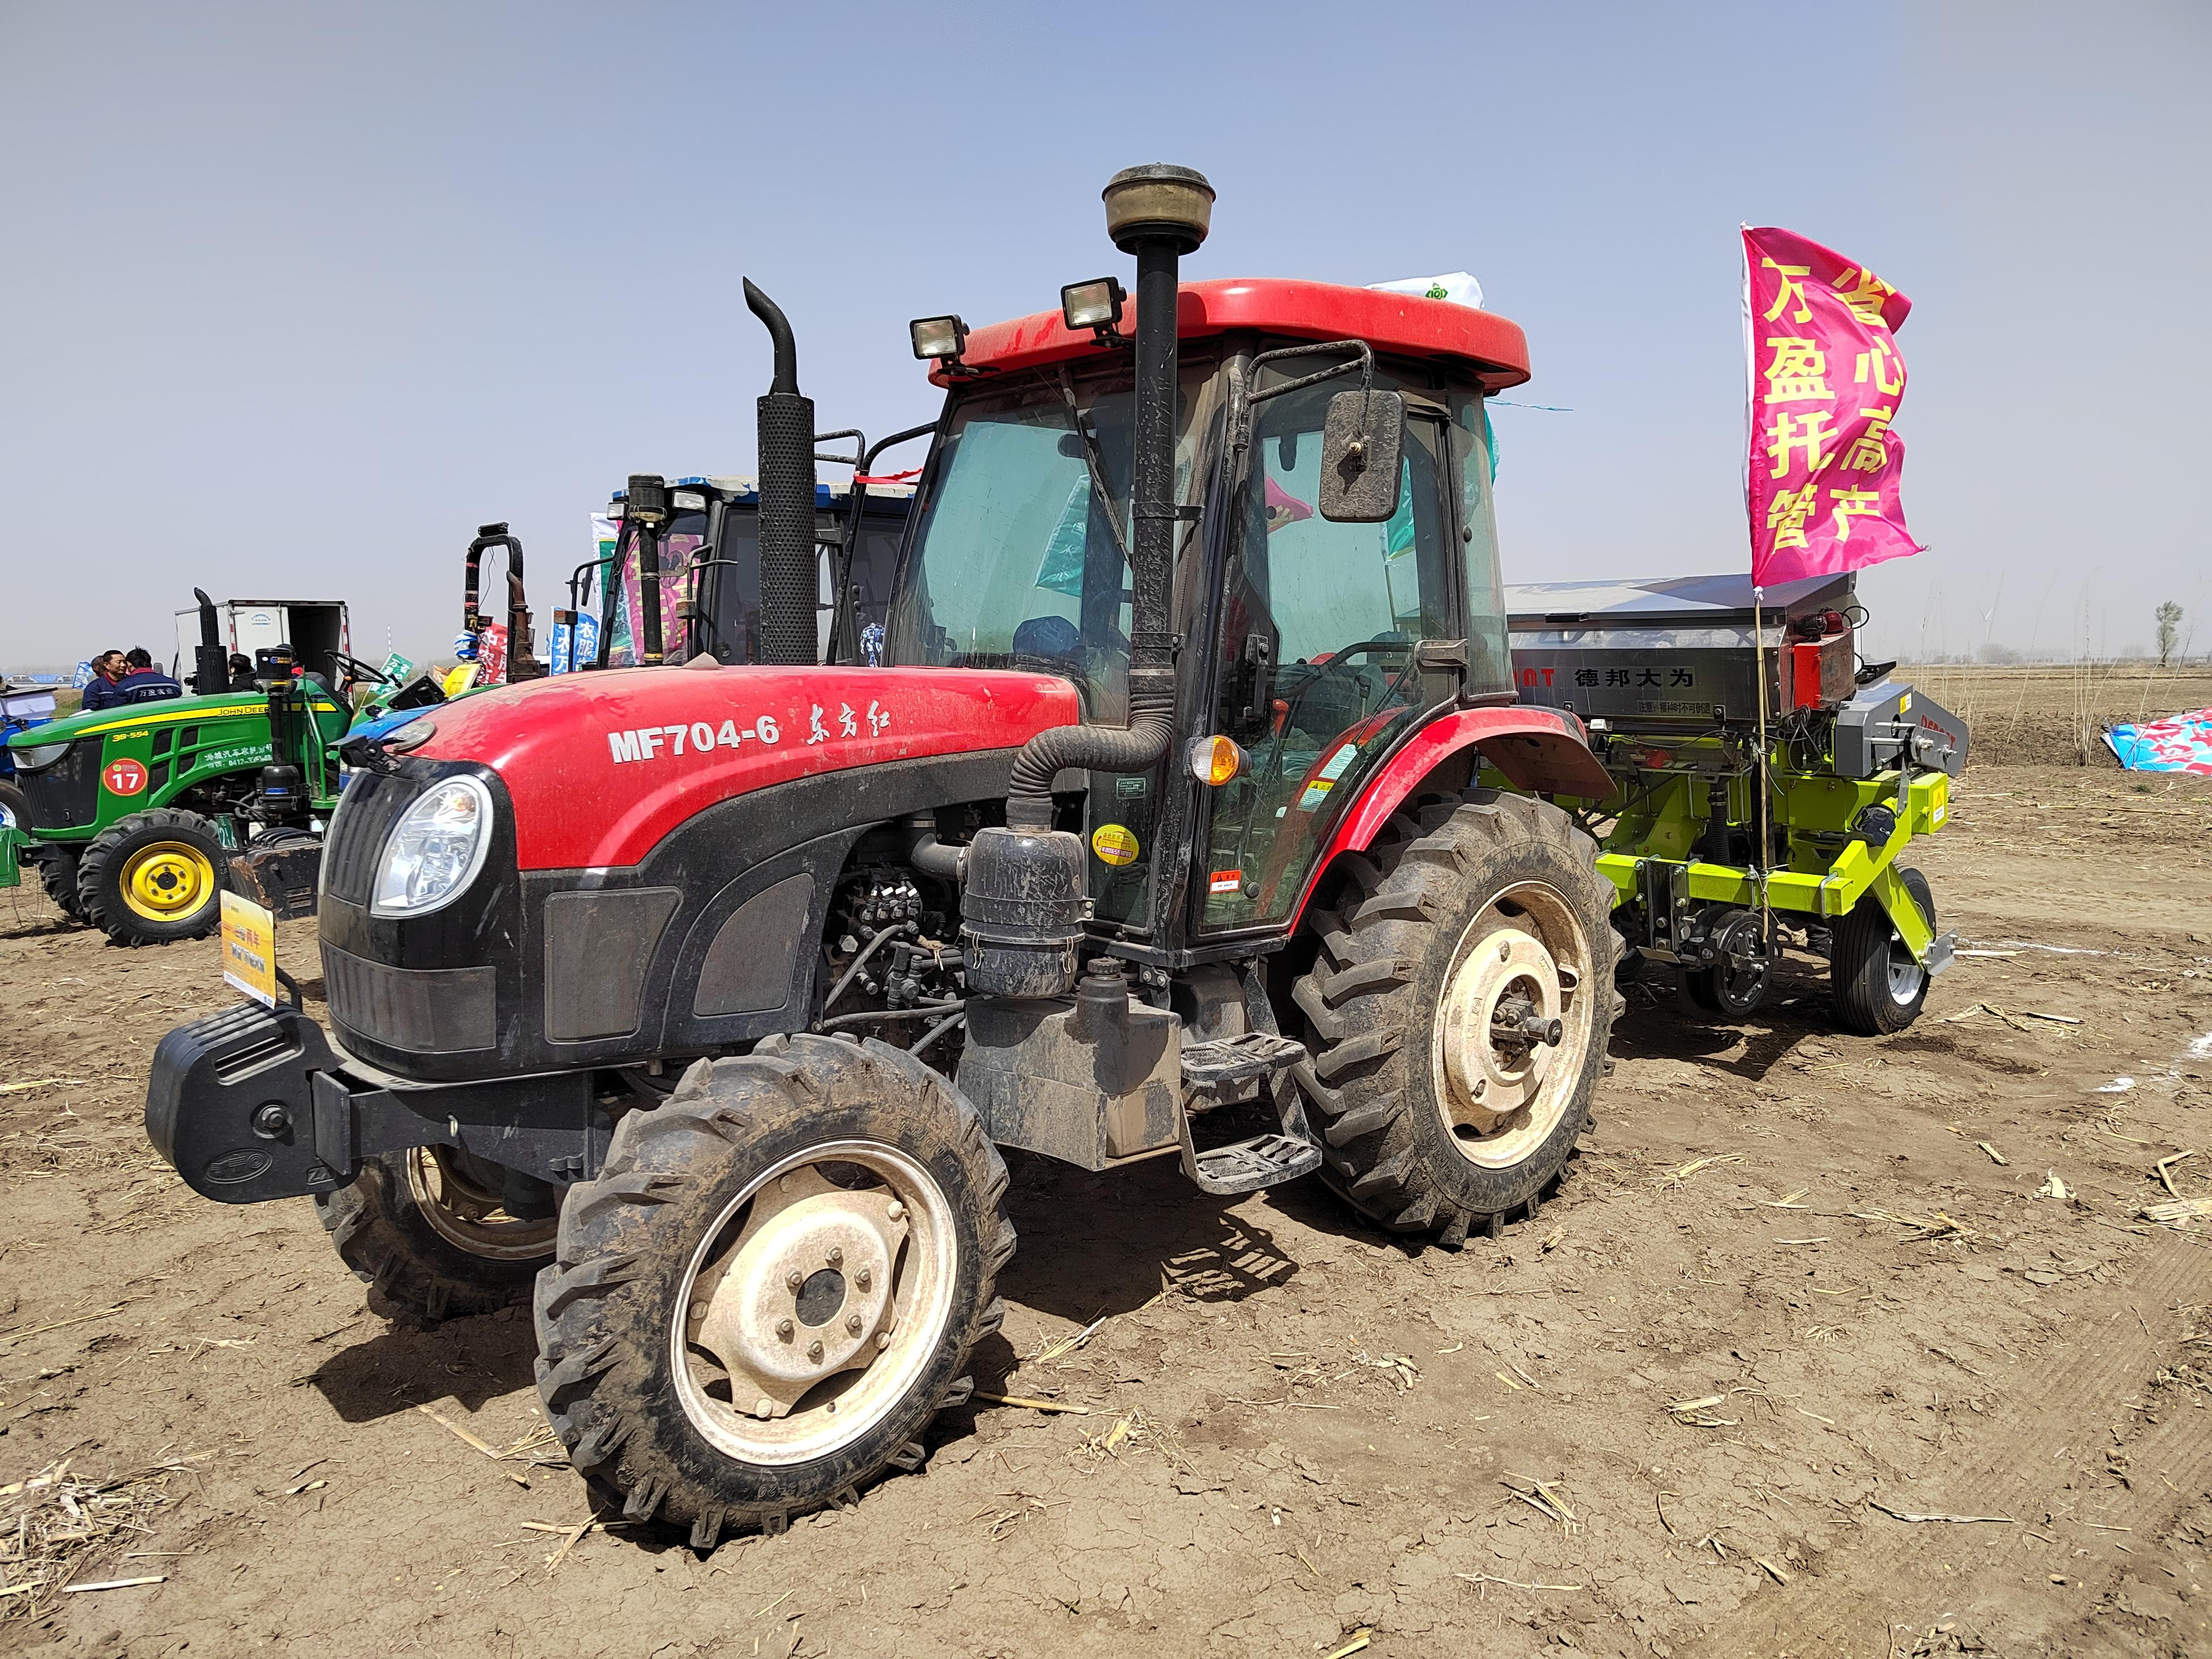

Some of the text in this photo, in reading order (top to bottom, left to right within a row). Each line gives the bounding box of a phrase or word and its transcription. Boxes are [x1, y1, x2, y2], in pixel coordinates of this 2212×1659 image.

[1761, 257, 1838, 554] 万盈托管
[1827, 266, 1905, 543] 省心高产
[1574, 669, 1694, 687] 德邦大为
[609, 716, 780, 763] MF704-6
[807, 700, 890, 745] 东方红
[112, 773, 139, 789] 17
